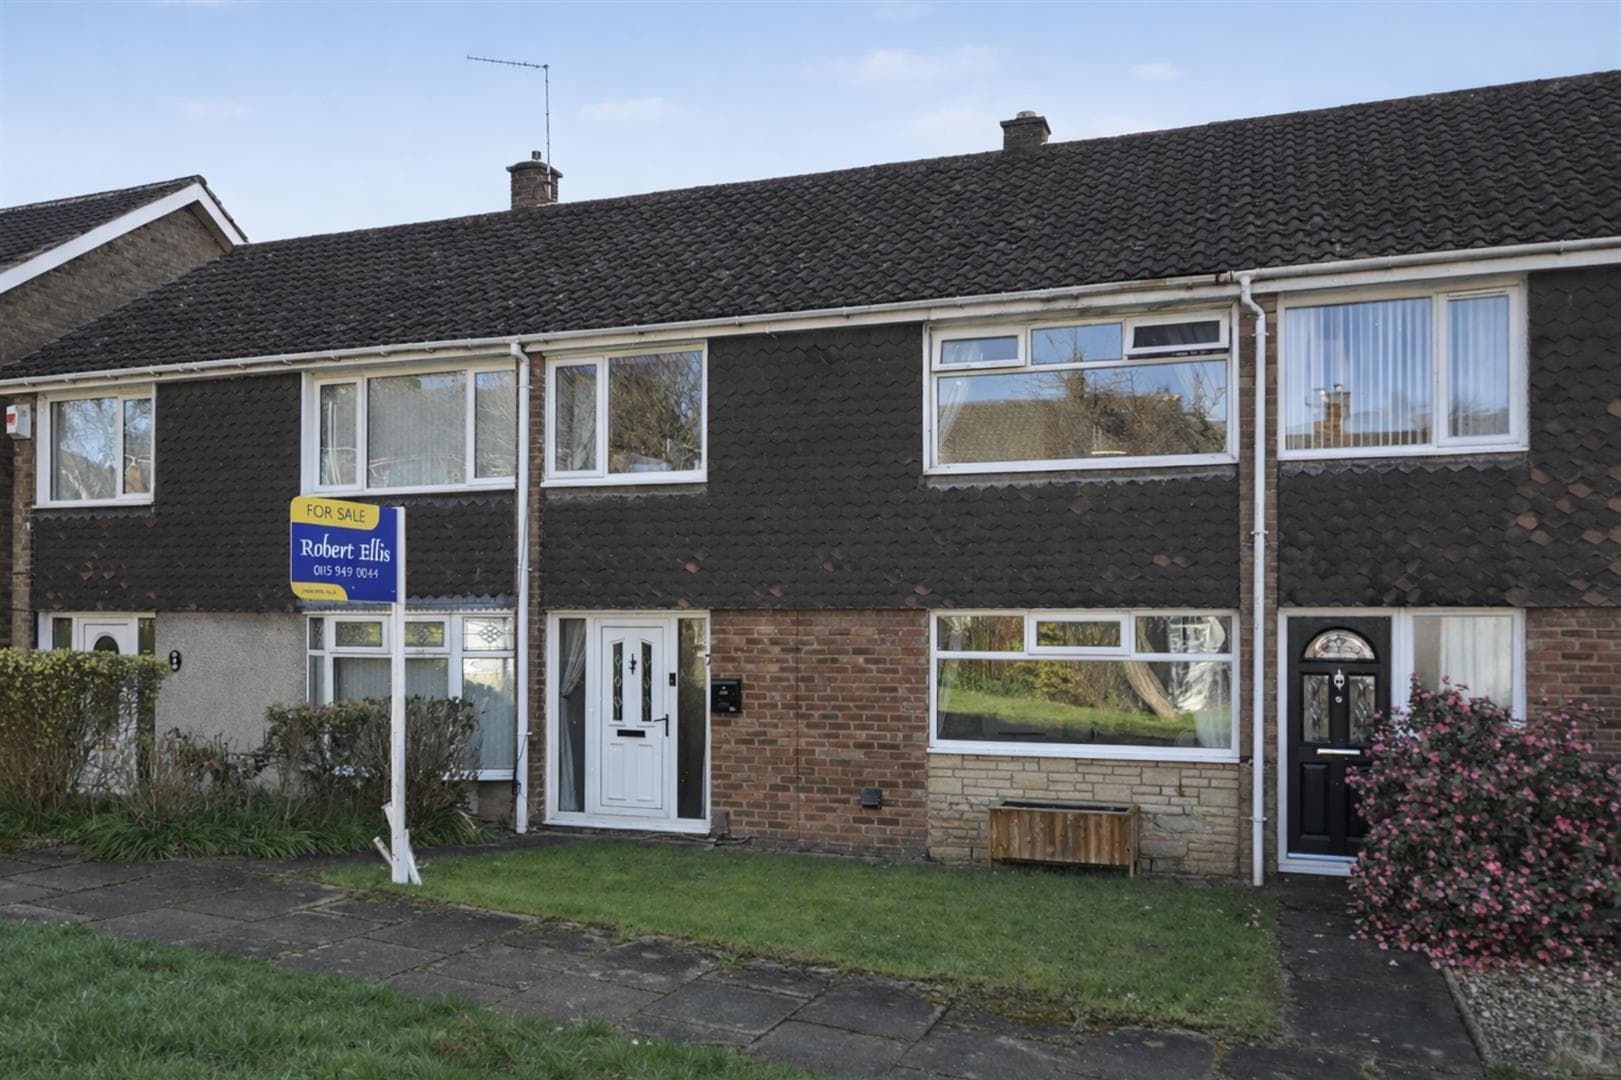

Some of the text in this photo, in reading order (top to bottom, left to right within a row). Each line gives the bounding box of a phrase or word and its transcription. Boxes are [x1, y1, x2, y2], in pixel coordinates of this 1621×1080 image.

[307, 504, 365, 522] FOR SALE
[300, 533, 390, 562] Robert Ellis
[313, 564, 378, 579] 0115 949 0044
